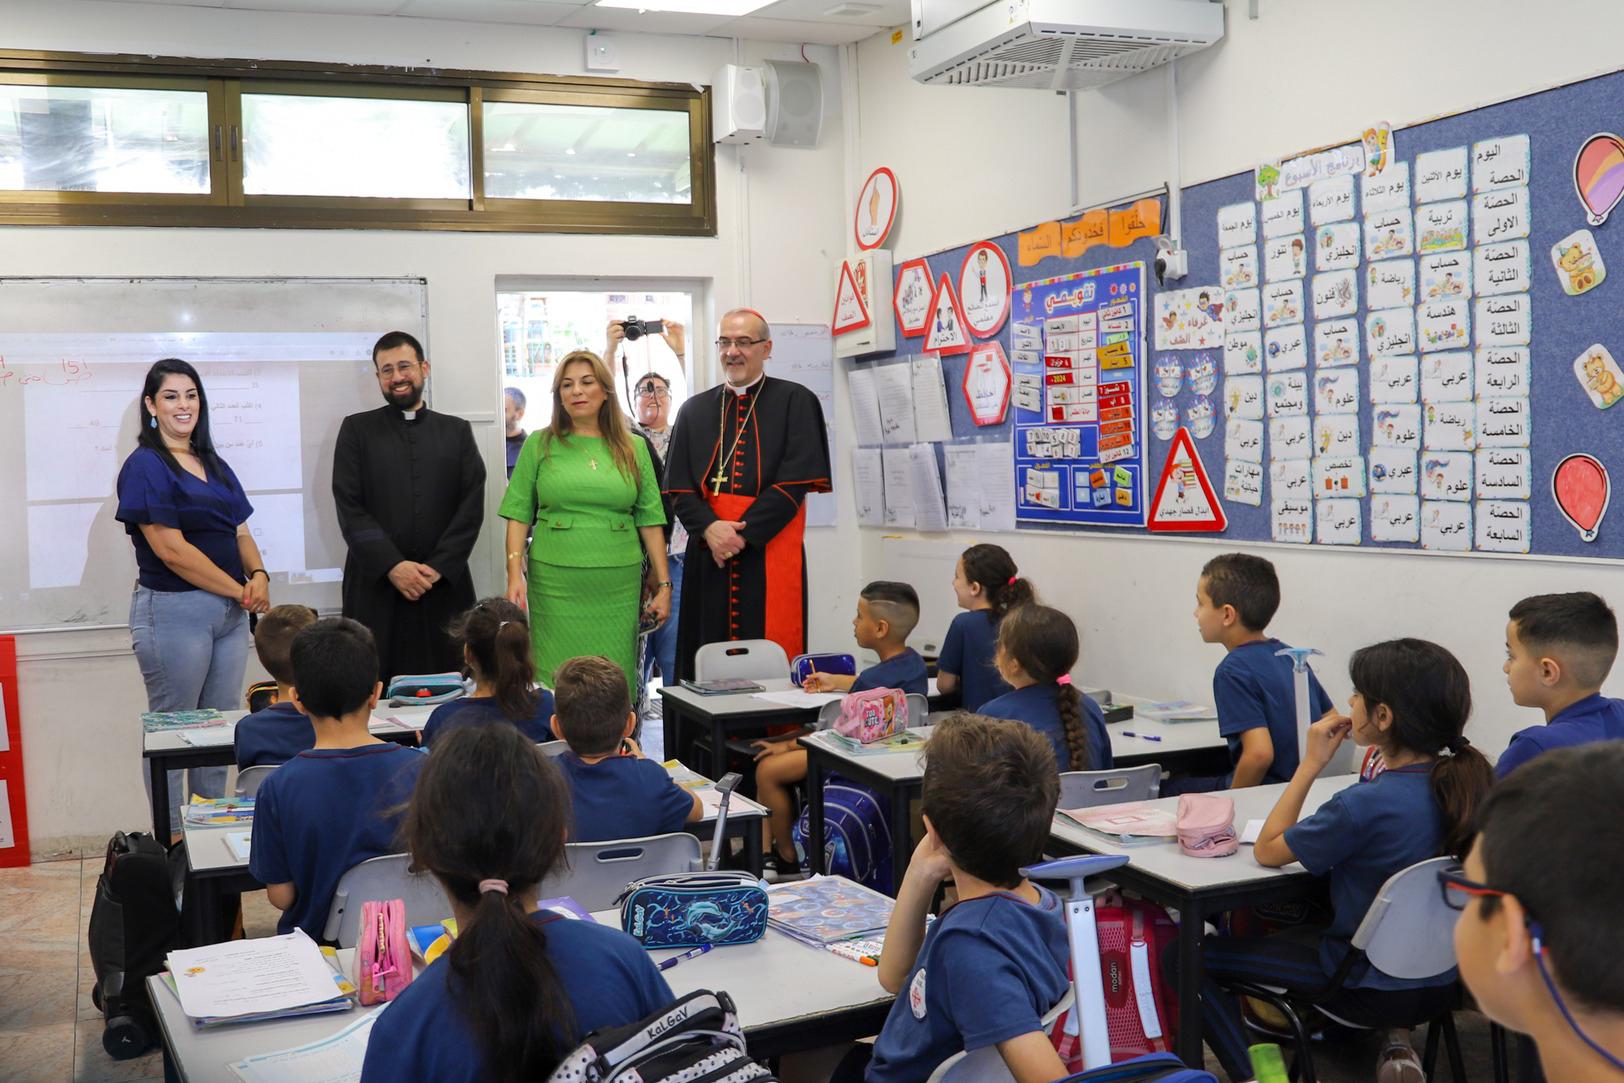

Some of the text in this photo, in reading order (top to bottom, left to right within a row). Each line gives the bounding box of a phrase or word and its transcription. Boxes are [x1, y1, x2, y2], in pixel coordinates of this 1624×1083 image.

[1477, 144, 1501, 161] اليوم
[1374, 218, 1401, 229] حساب
[1430, 258, 1459, 270] حساب
[1388, 374, 1412, 388] عربي
[1441, 372, 1467, 388] عربي
[1482, 423, 1522, 436] الخامسة
[1285, 432, 1306, 446] عربي
[1286, 475, 1307, 488] عربي
[1482, 473, 1522, 487] السادسة
[1335, 517, 1356, 530] عربي
[1389, 512, 1413, 525] عربي
[1440, 522, 1465, 534] عربي
[1487, 527, 1522, 541] السابعة
[1110, 961, 1119, 993] modan
